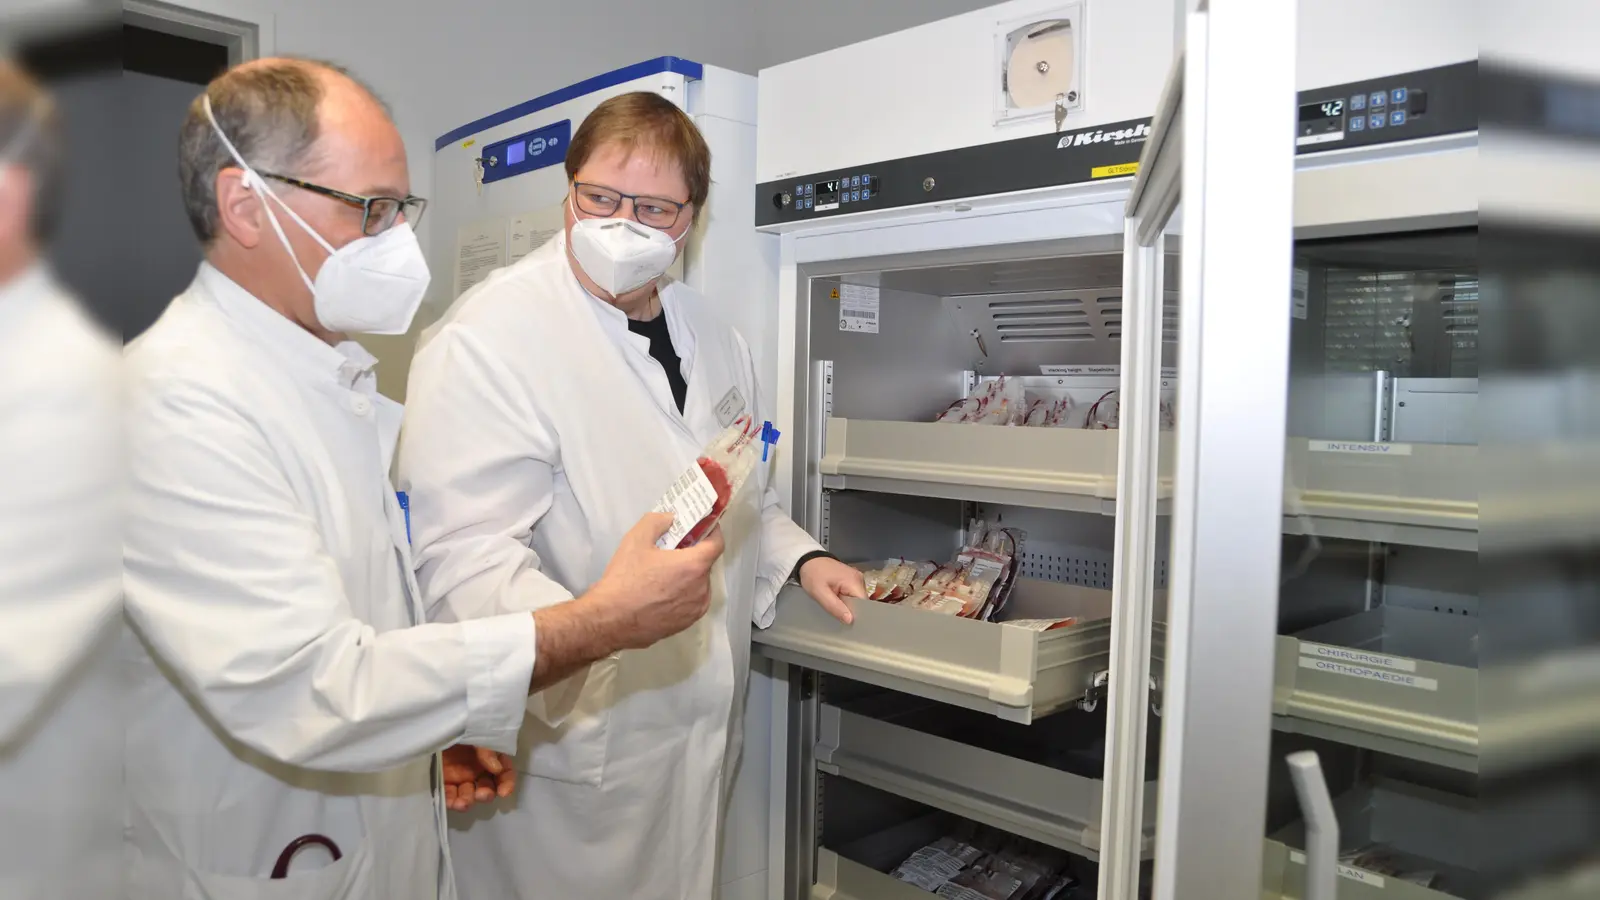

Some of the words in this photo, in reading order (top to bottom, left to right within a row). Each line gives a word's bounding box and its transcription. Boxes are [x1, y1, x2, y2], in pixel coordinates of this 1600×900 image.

[1073, 123, 1151, 147] Kirsch
[1327, 443, 1391, 452] INTENSIV
[1317, 647, 1393, 666] CHIRURGIE
[1315, 661, 1415, 684] ORTHOPAEDIE
